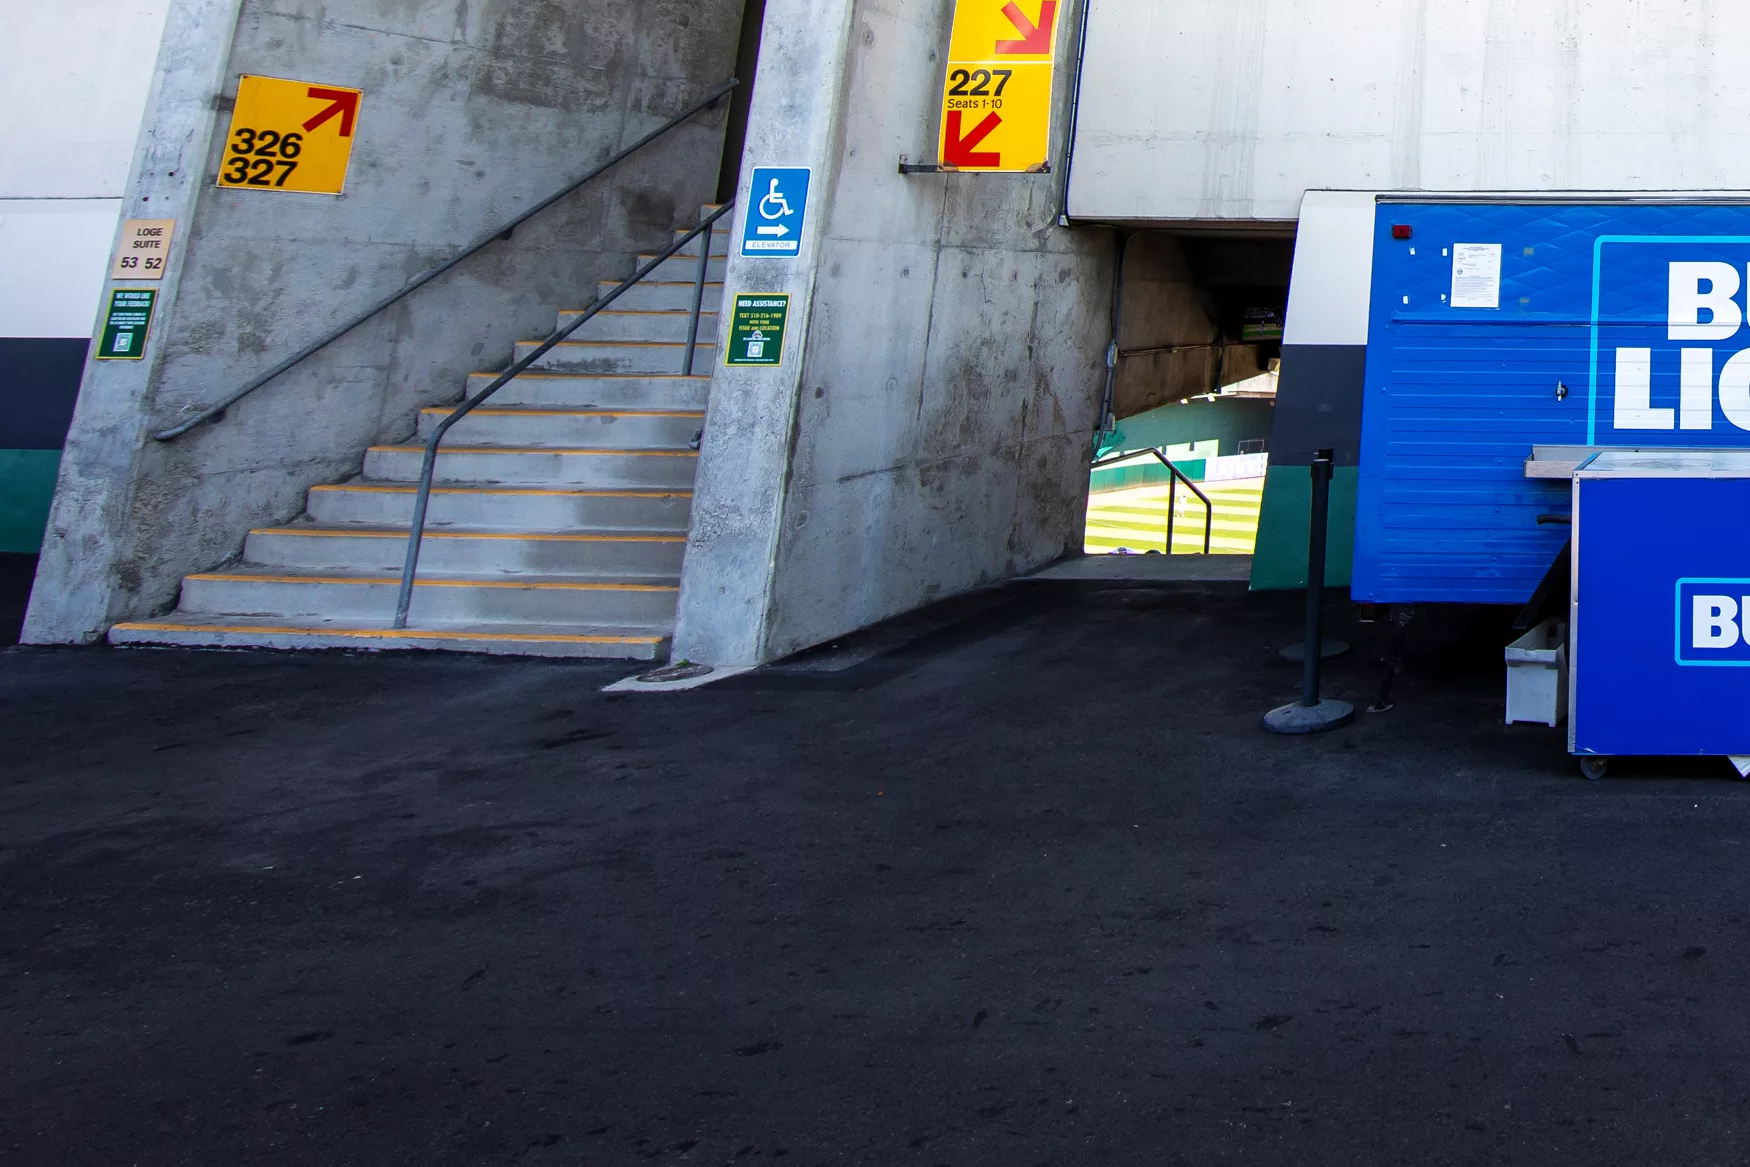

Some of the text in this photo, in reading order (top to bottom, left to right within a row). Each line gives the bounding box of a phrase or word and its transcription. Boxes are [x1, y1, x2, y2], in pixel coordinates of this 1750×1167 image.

[948, 69, 1012, 97] 227
[947, 98, 1003, 109] Seats 1-10
[231, 127, 303, 159] 326
[223, 156, 298, 187] 327
[136, 227, 163, 236] LOGE
[132, 240, 161, 248] SUITE
[120, 256, 162, 269] 53 52
